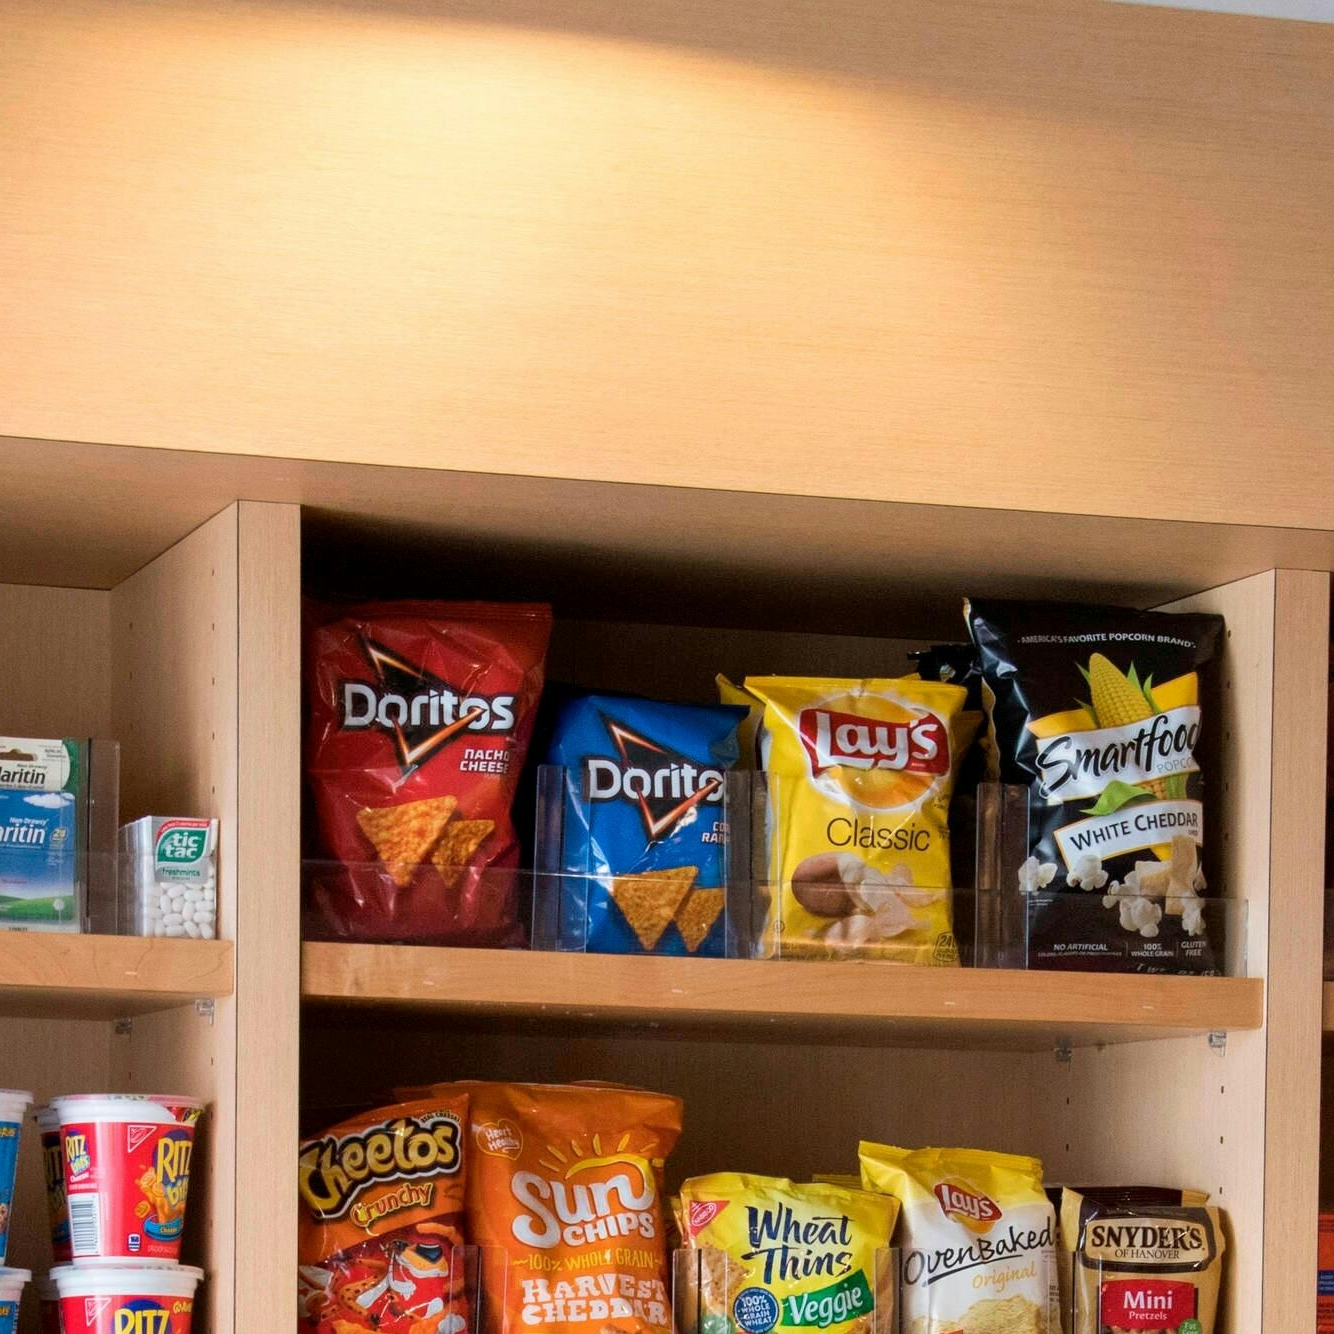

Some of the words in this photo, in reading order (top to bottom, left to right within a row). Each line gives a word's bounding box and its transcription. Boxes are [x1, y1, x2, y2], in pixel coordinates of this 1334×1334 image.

[1109, 633, 1155, 643] POPCORN
[342, 683, 515, 731] Doritos
[815, 711, 939, 770] Lay's
[173, 832, 200, 846] tic
[826, 817, 931, 852] Classic
[1069, 820, 1132, 851] WHITE
[1134, 811, 1199, 832] CHEDDAR
[166, 844, 198, 859] tac
[299, 1117, 456, 1211] Cheetos
[351, 1182, 434, 1227] Crunchy
[511, 1160, 656, 1250] Sun
[940, 1184, 993, 1219] Lay's
[745, 1202, 854, 1250] Wheat
[1091, 1224, 1203, 1251] SNYDER'S
[741, 1246, 854, 1284] Thins
[1114, 1249, 1129, 1259] OF
[1130, 1250, 1180, 1260] HANOVER
[522, 1273, 665, 1304] HARVEST
[1123, 1290, 1173, 1310] Mini
[522, 1299, 667, 1327] CHEDDAR
[788, 1285, 864, 1328] Veggie
[1128, 1310, 1168, 1321] Pretzels
